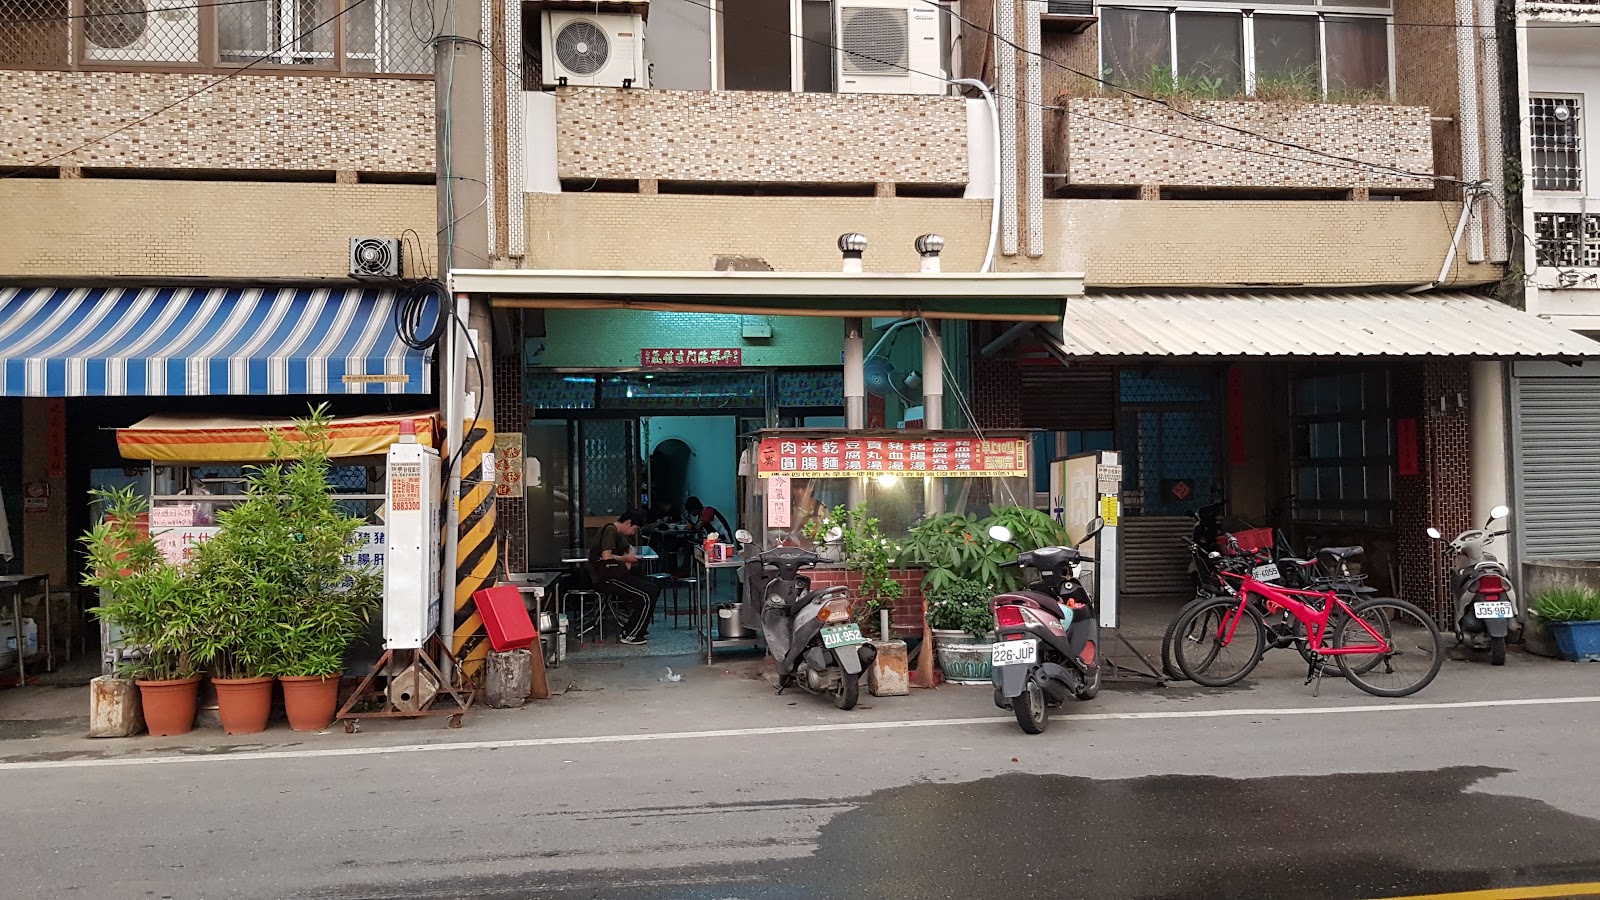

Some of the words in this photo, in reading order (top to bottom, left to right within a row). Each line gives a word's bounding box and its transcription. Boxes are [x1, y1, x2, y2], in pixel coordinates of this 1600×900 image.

[781, 441, 797, 470] 肉圓
[801, 441, 818, 470] 米腸
[822, 441, 839, 470] 乾麵
[845, 441, 861, 470] 豆腐湯
[867, 441, 883, 470] 貢丸湯
[888, 441, 904, 470] 豬血湯
[910, 441, 926, 470] 豬腸湯
[393, 502, 420, 510] 5883300
[1477, 607, 1510, 615] J35-987
[823, 630, 861, 645] ZUX-952
[994, 647, 1034, 662] 226-JUP
